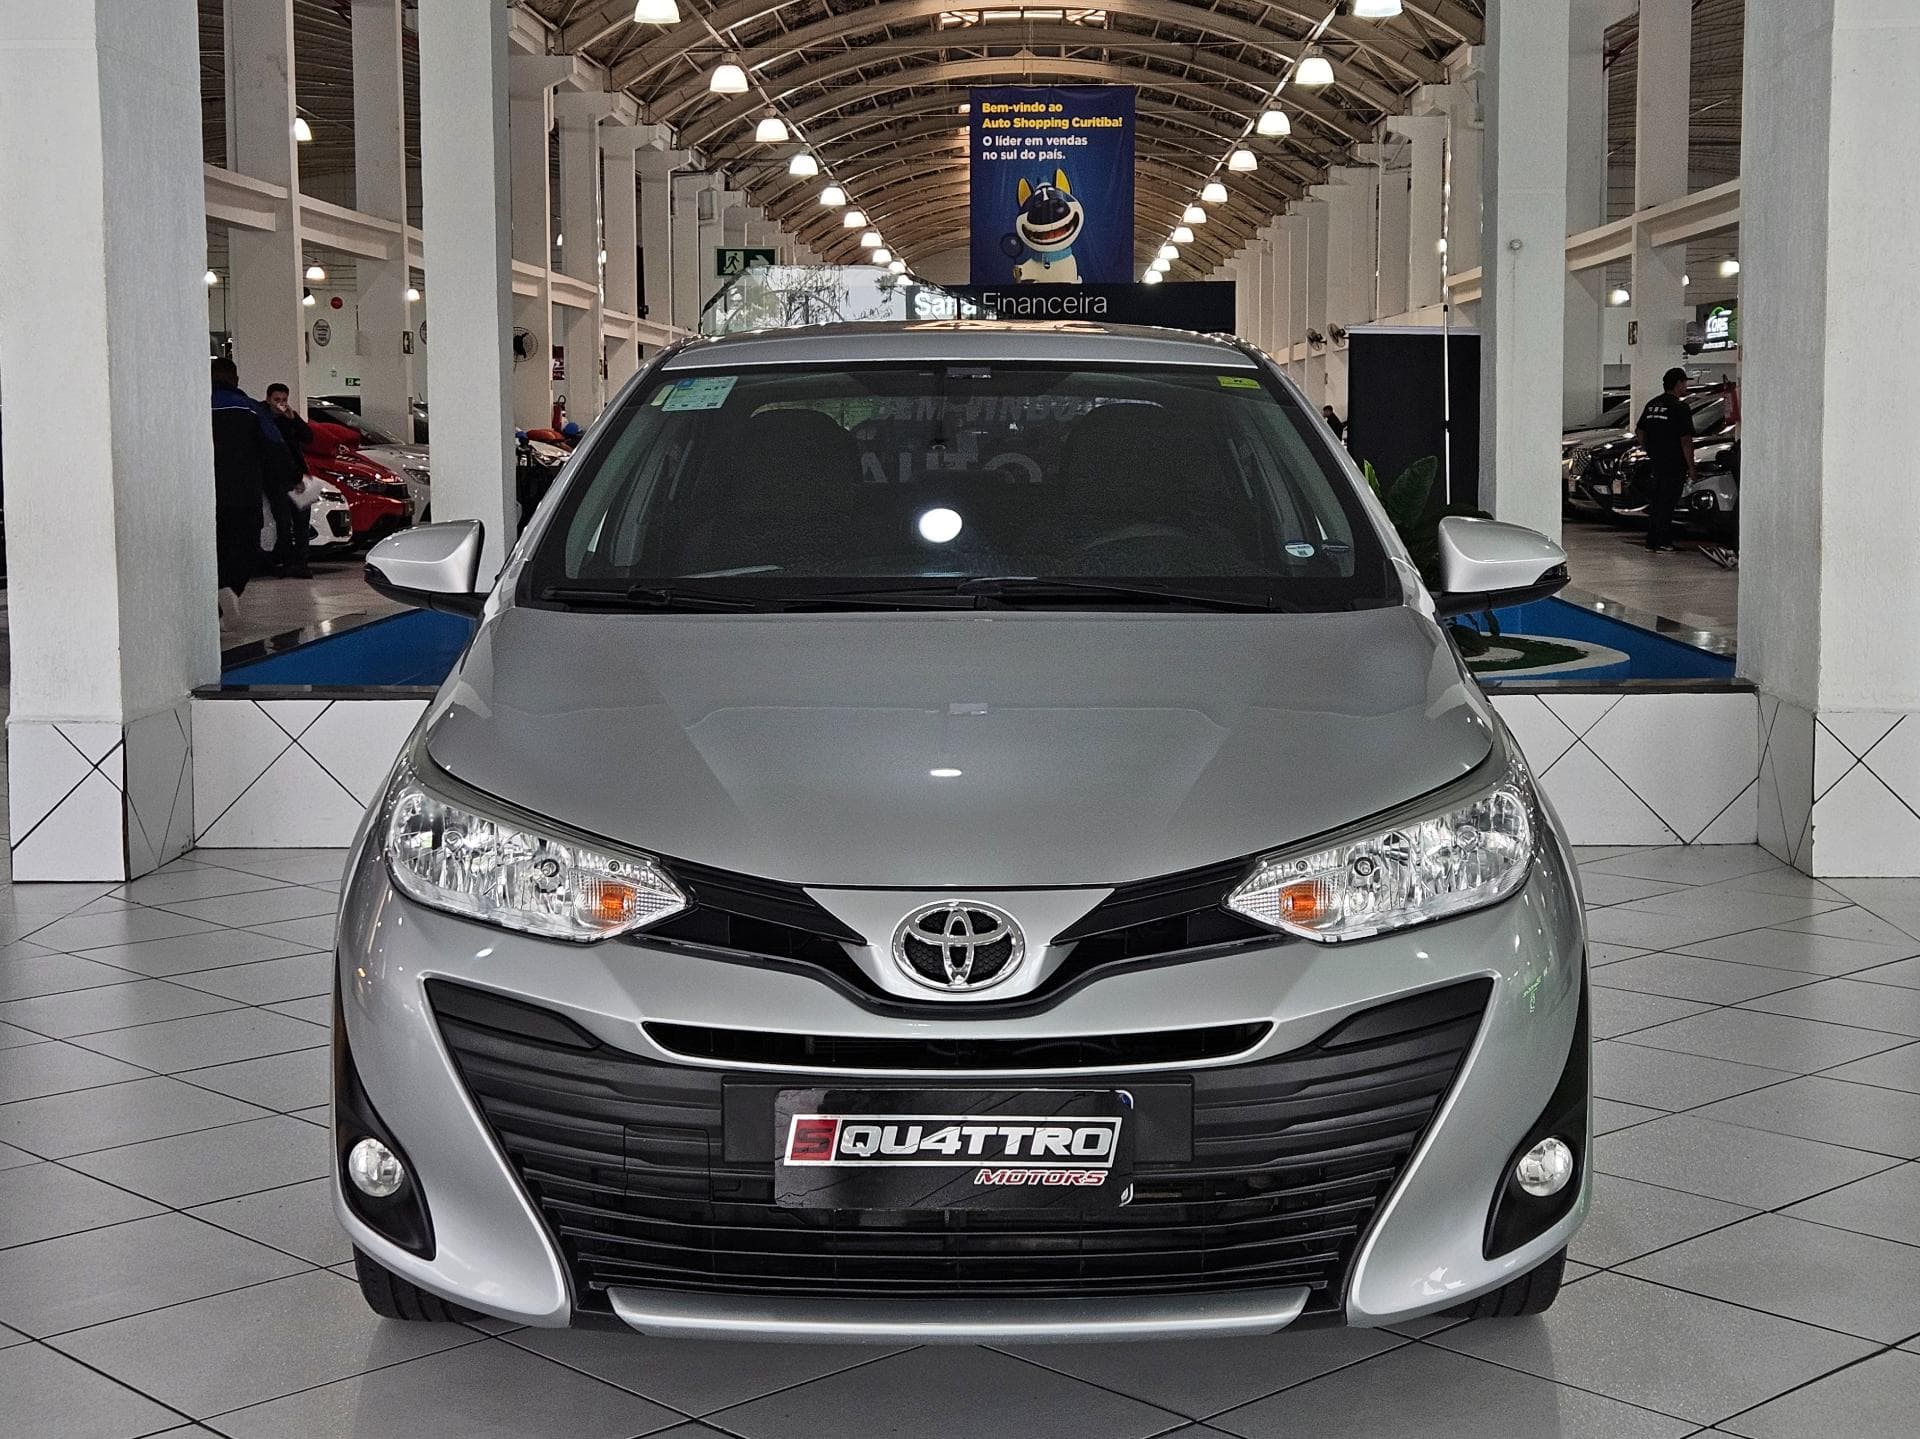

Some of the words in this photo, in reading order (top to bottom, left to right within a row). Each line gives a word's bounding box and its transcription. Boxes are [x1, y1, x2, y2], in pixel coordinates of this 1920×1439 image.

[982, 102, 1046, 113] Bem-vindo
[1048, 104, 1063, 113] ao
[982, 118, 1011, 129] Auto
[1013, 117, 1070, 130] Shopping
[1072, 116, 1123, 128] Curitiba!
[982, 136, 993, 147] O
[995, 135, 1022, 146] líder
[1024, 137, 1043, 146] em
[1046, 135, 1088, 146] vendas
[982, 151, 998, 160] no
[1000, 149, 1017, 160] sul
[1020, 149, 1036, 160] do
[1038, 148, 1066, 162] país.
[983, 292, 1108, 315] Financeira
[973, 1168, 1109, 1186] MOTORS
